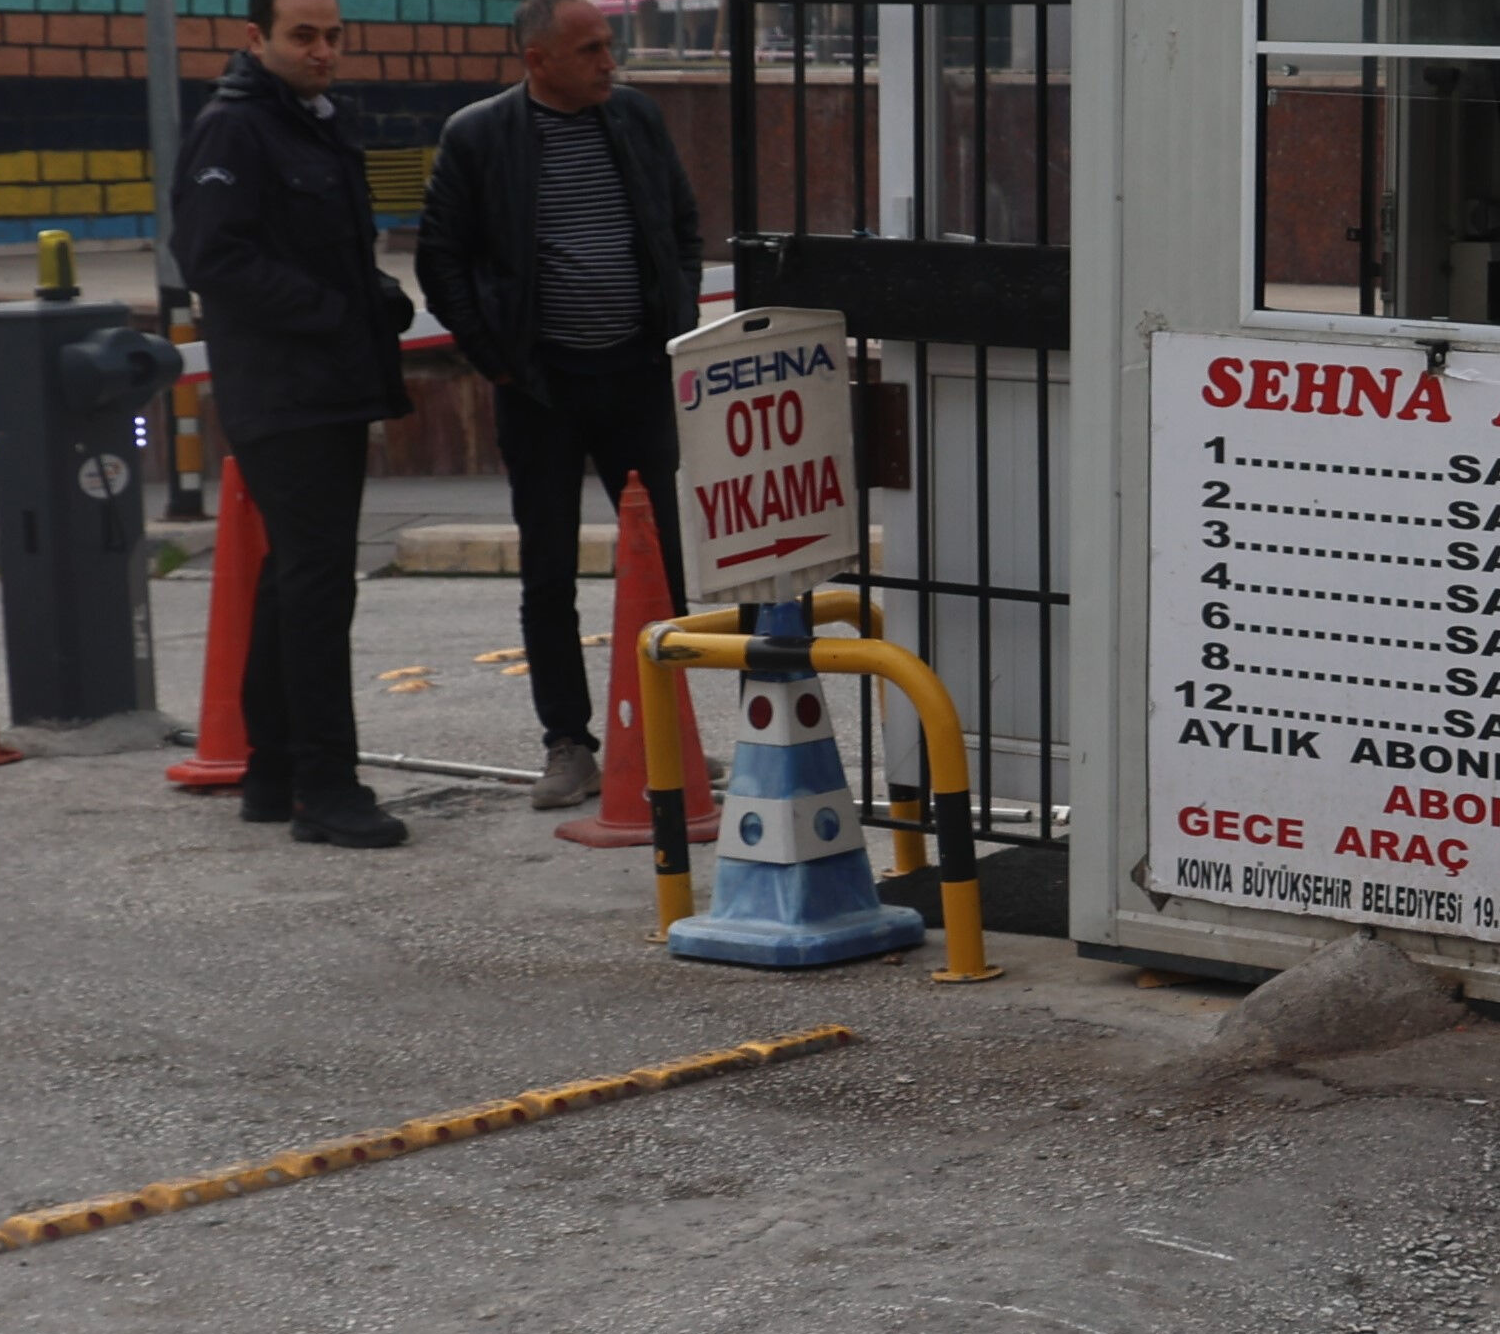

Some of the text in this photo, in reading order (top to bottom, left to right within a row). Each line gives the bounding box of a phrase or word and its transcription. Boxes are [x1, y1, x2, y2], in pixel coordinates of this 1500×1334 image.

[706, 343, 836, 396] SEHNA
[1201, 357, 1452, 424] SEHNA
[726, 389, 804, 457] OTO
[1203, 437, 1226, 464] 1
[695, 455, 844, 539] YIKAMA
[1202, 481, 1231, 509] 2
[1202, 521, 1232, 549] 3
[1201, 562, 1232, 591] 4
[1201, 602, 1231, 630] 6
[1201, 643, 1231, 671] 8
[1175, 680, 1233, 712] 12
[1178, 718, 1321, 760] AYLIK
[1177, 806, 1305, 850] GECE
[1334, 826, 1470, 877] ARAÇ
[1176, 857, 1233, 894] KONYA
